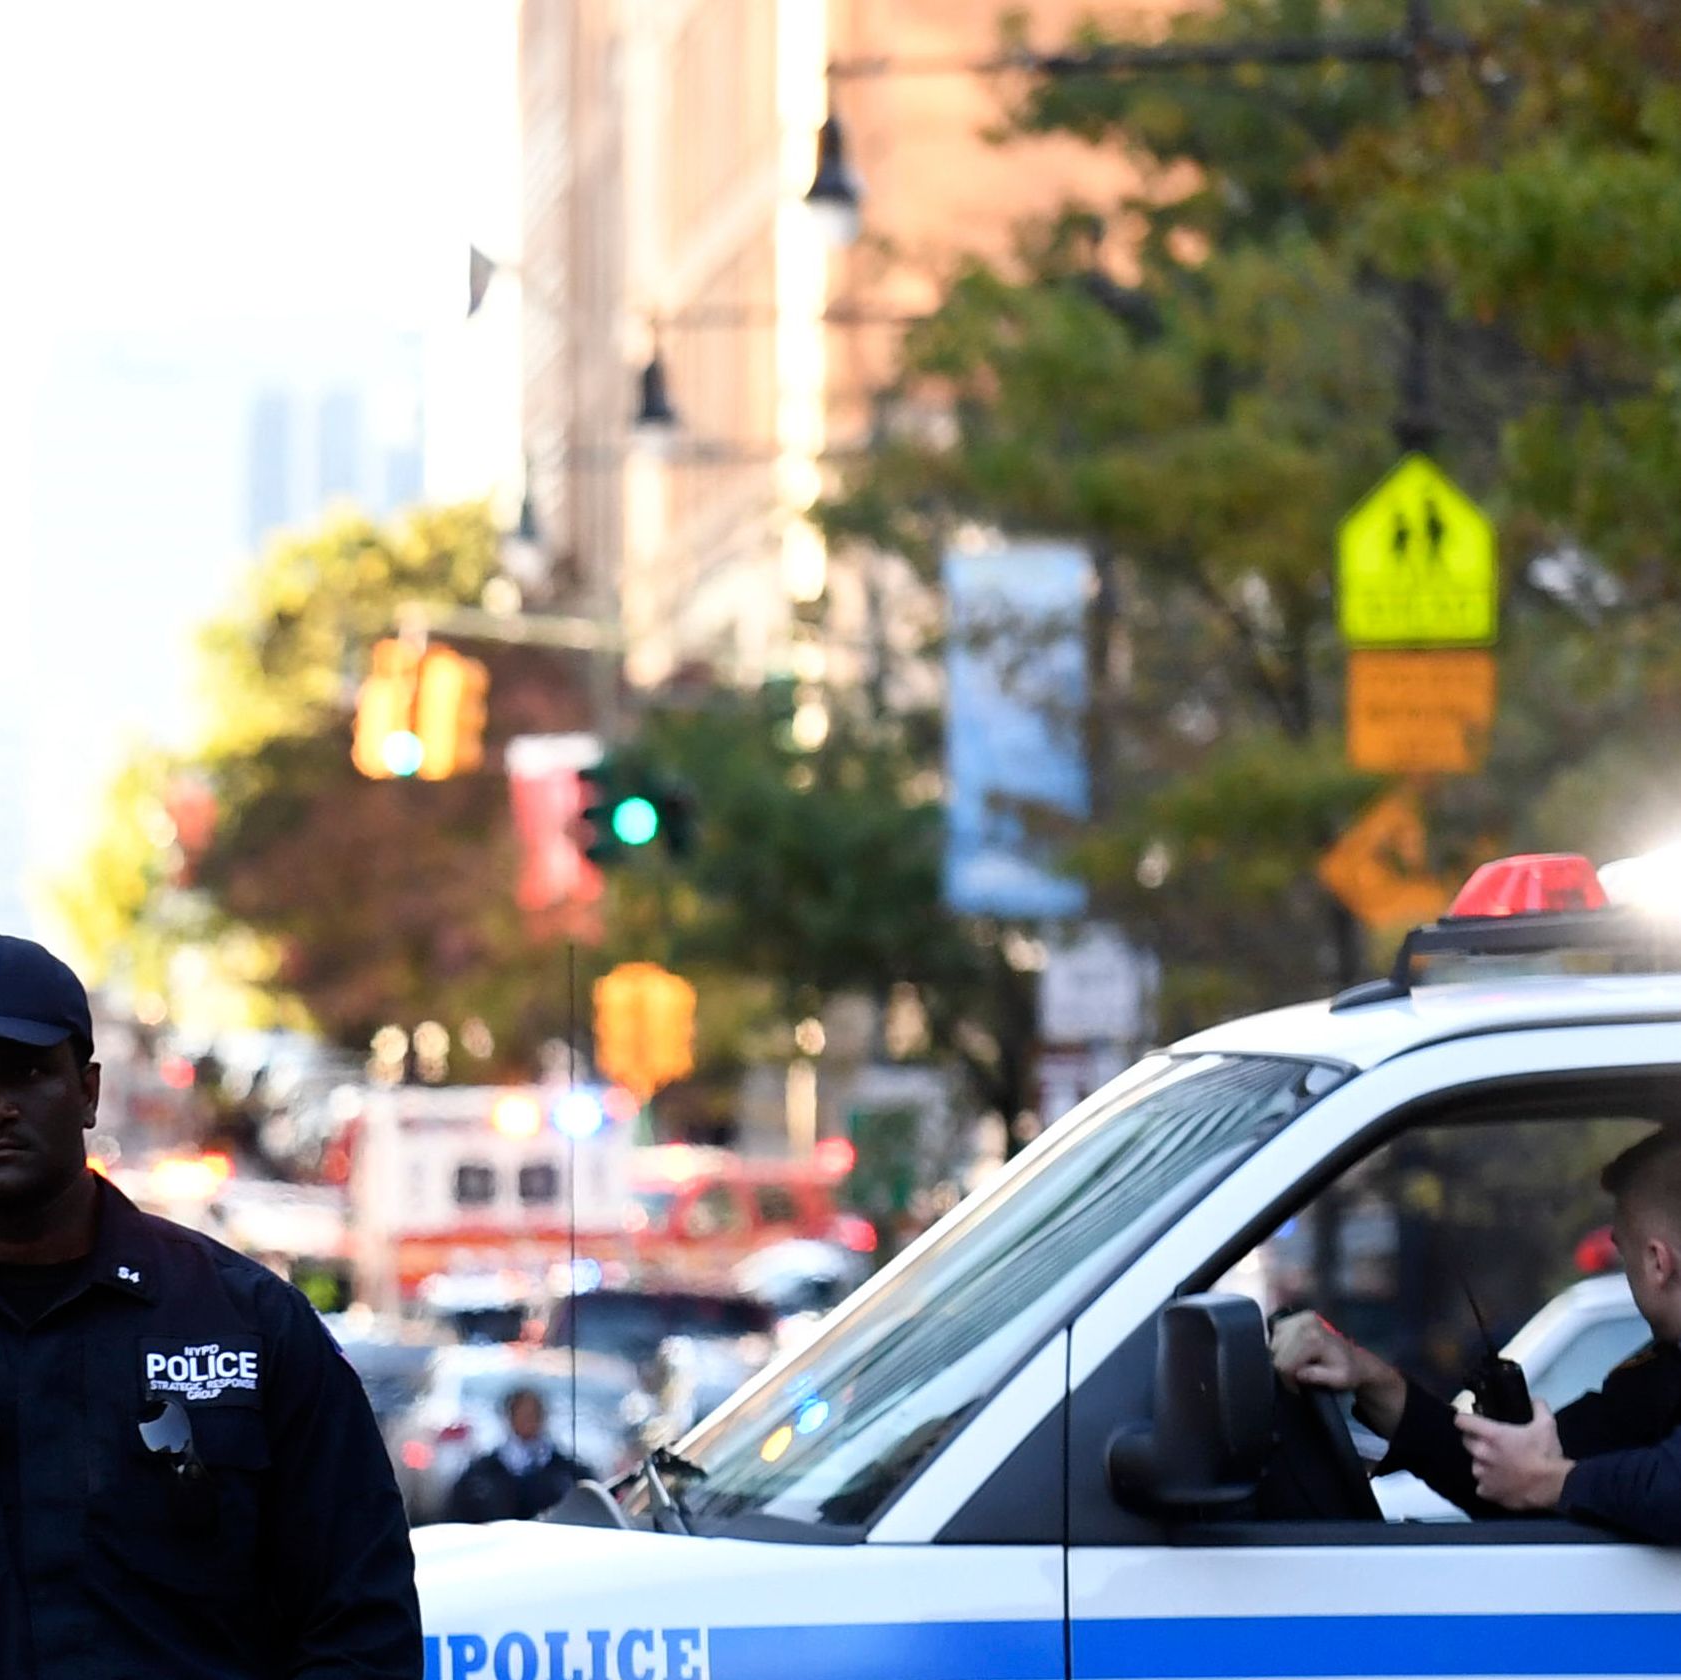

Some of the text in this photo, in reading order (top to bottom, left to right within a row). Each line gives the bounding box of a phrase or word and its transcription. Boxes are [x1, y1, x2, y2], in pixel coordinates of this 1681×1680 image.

[184, 1344, 219, 1357] NYPD
[146, 1351, 258, 1382] POLICE
[150, 1378, 256, 1392] STRATEGIC RESPONSE
[186, 1388, 222, 1401] GROUP
